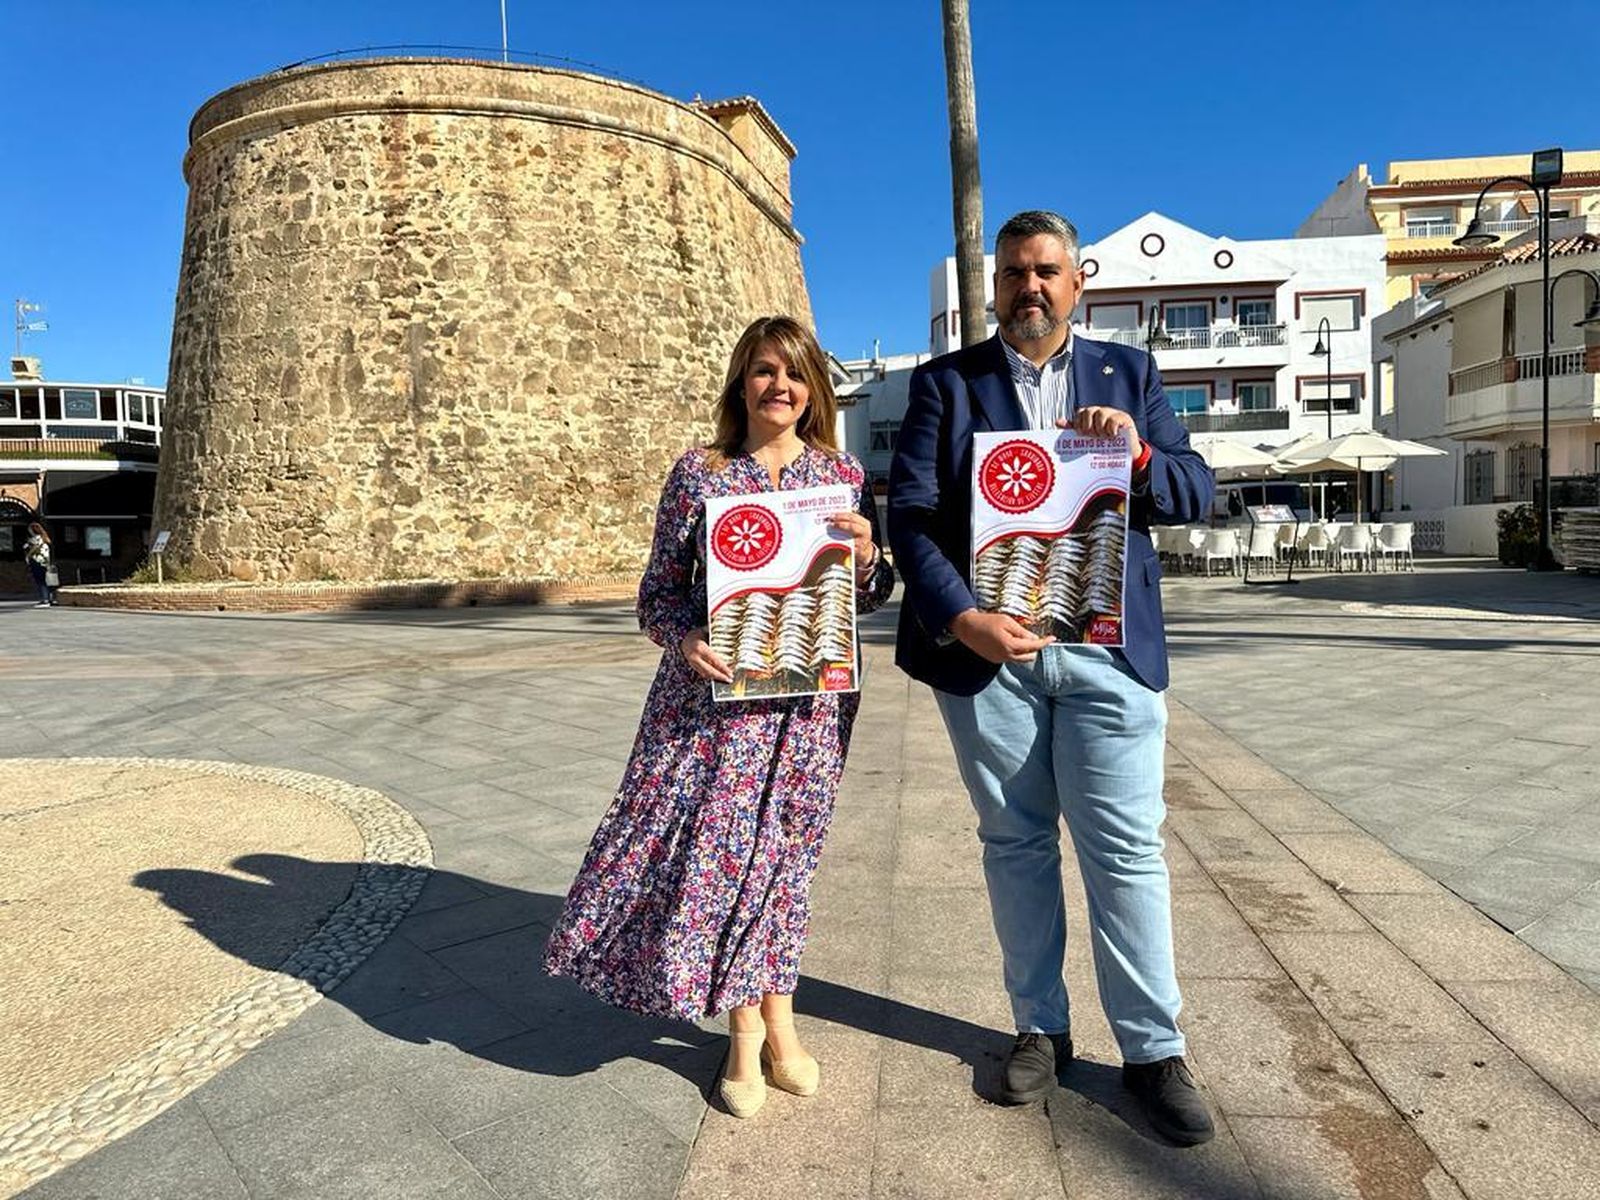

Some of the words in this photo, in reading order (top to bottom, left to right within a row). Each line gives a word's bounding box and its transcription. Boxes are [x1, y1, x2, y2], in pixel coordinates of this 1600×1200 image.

[1062, 439, 1072, 449] DE
[1074, 438, 1094, 448] MAYO
[1096, 438, 1105, 448] DE
[787, 500, 796, 509] DE
[798, 498, 817, 508] MAYO
[818, 496, 827, 506] DE
